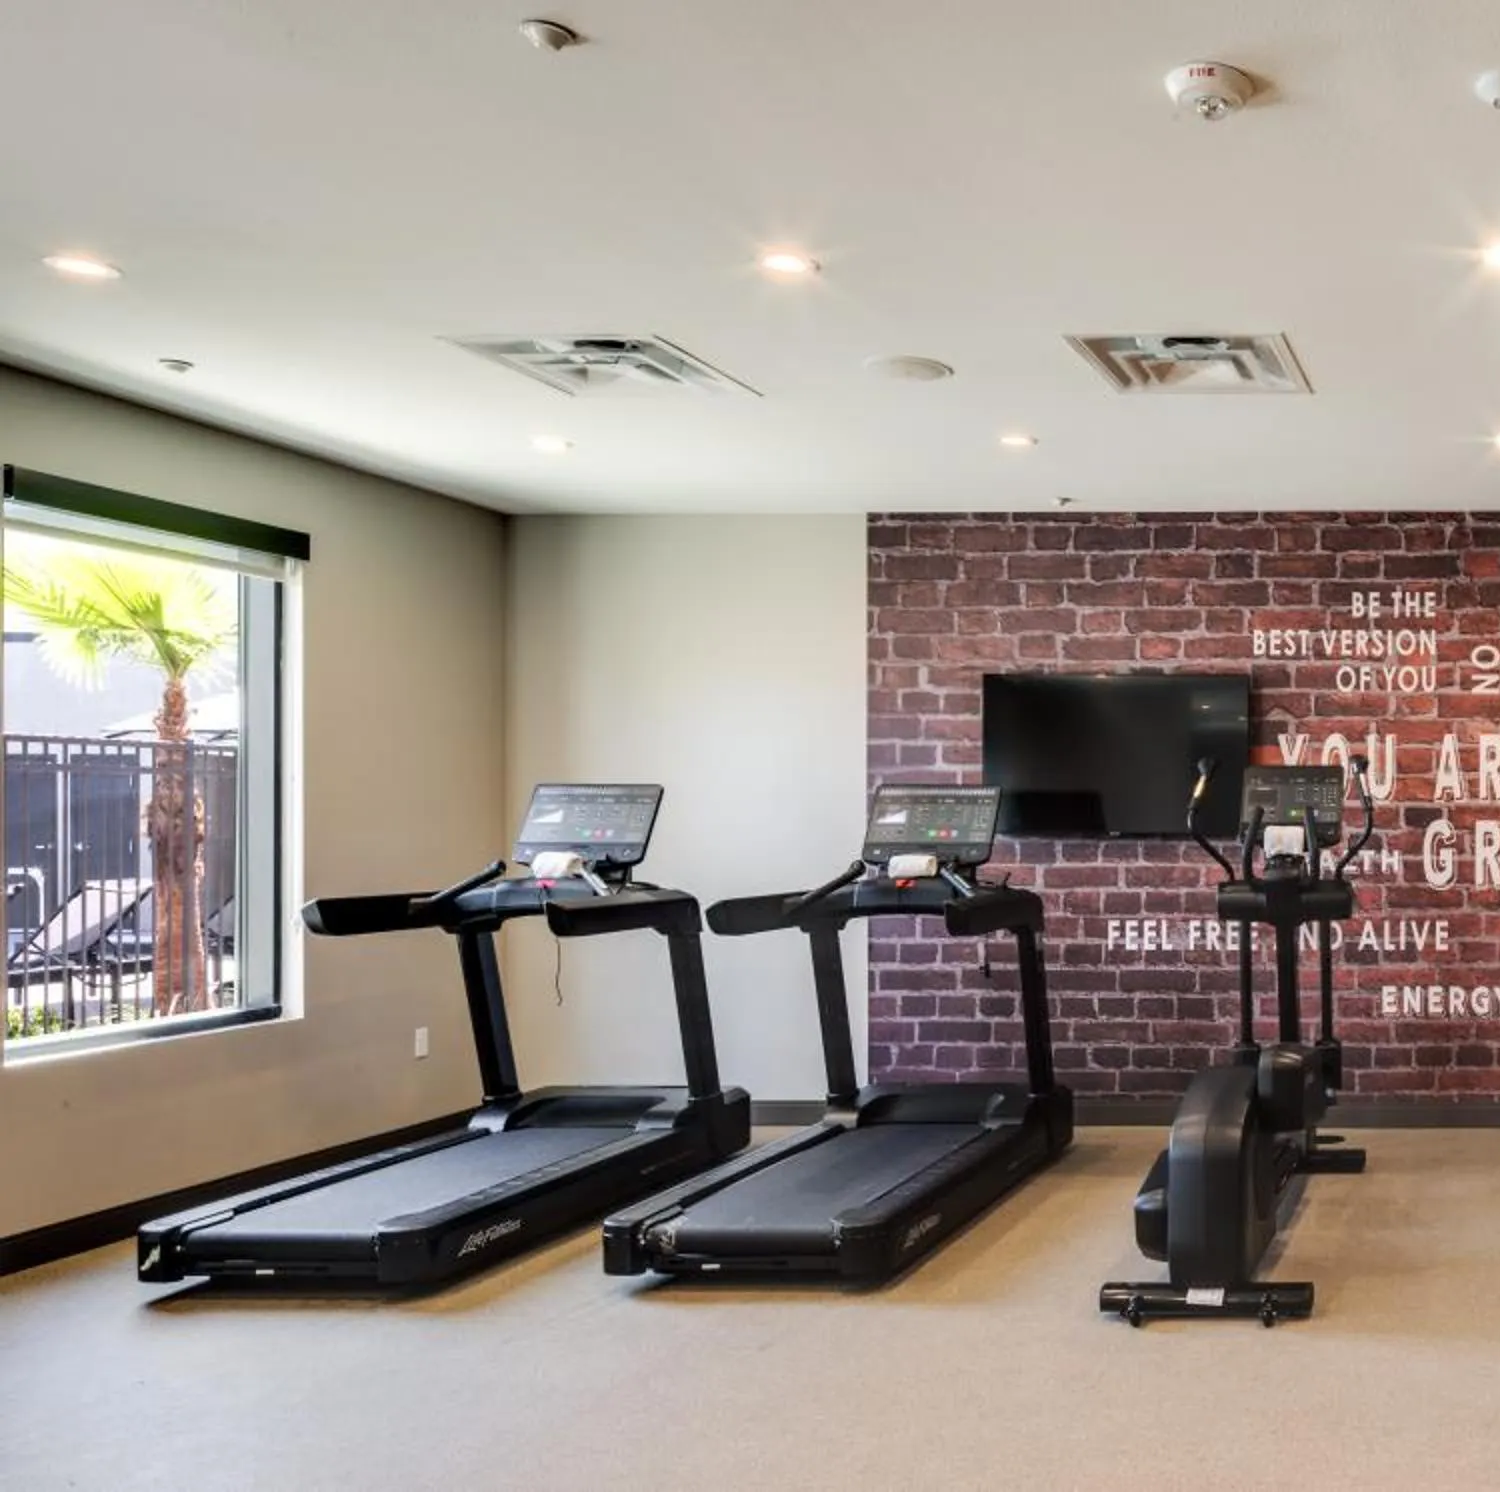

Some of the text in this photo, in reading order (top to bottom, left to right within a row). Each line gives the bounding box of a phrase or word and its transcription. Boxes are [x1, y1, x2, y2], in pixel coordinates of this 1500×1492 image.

[1351, 592, 1436, 618] BE THE
[1253, 629, 1436, 656] BEST VERSION
[1336, 666, 1436, 693] OF YOU
[1472, 645, 1500, 693] NO
[1107, 920, 1173, 950] FEEL
[1274, 920, 1344, 950] ND
[1358, 920, 1449, 950] ALIVE
